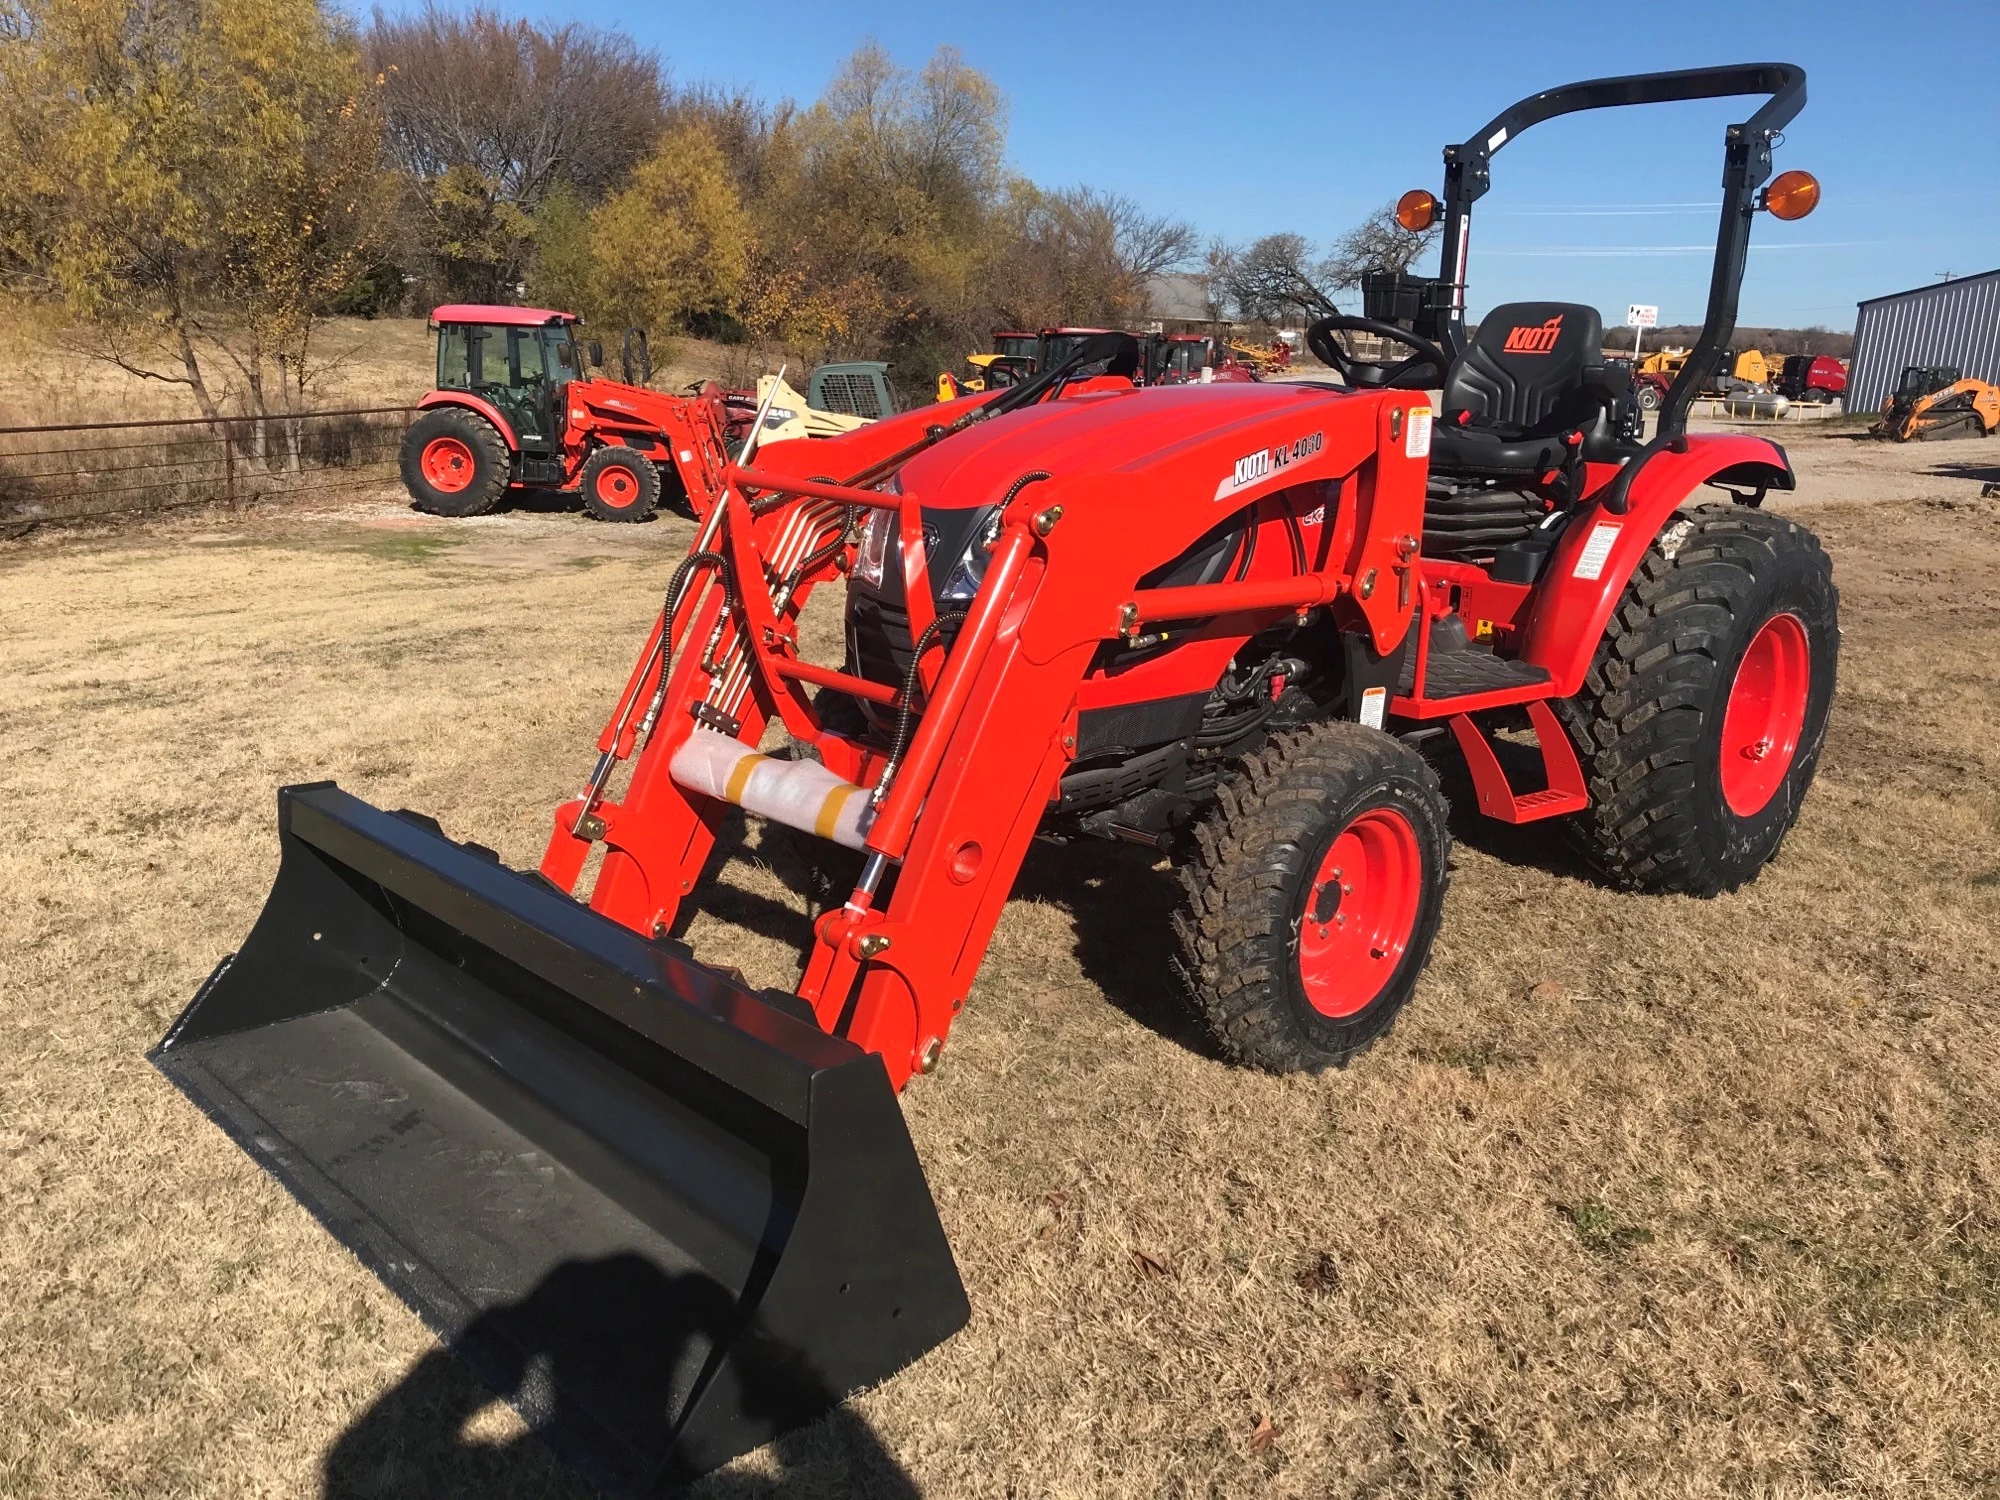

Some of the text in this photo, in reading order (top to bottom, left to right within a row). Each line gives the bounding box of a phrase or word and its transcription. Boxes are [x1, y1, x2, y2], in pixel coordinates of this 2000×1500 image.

[1504, 326, 1561, 350] KIOTI
[1234, 432, 1322, 487] KIOTI KL 4030
